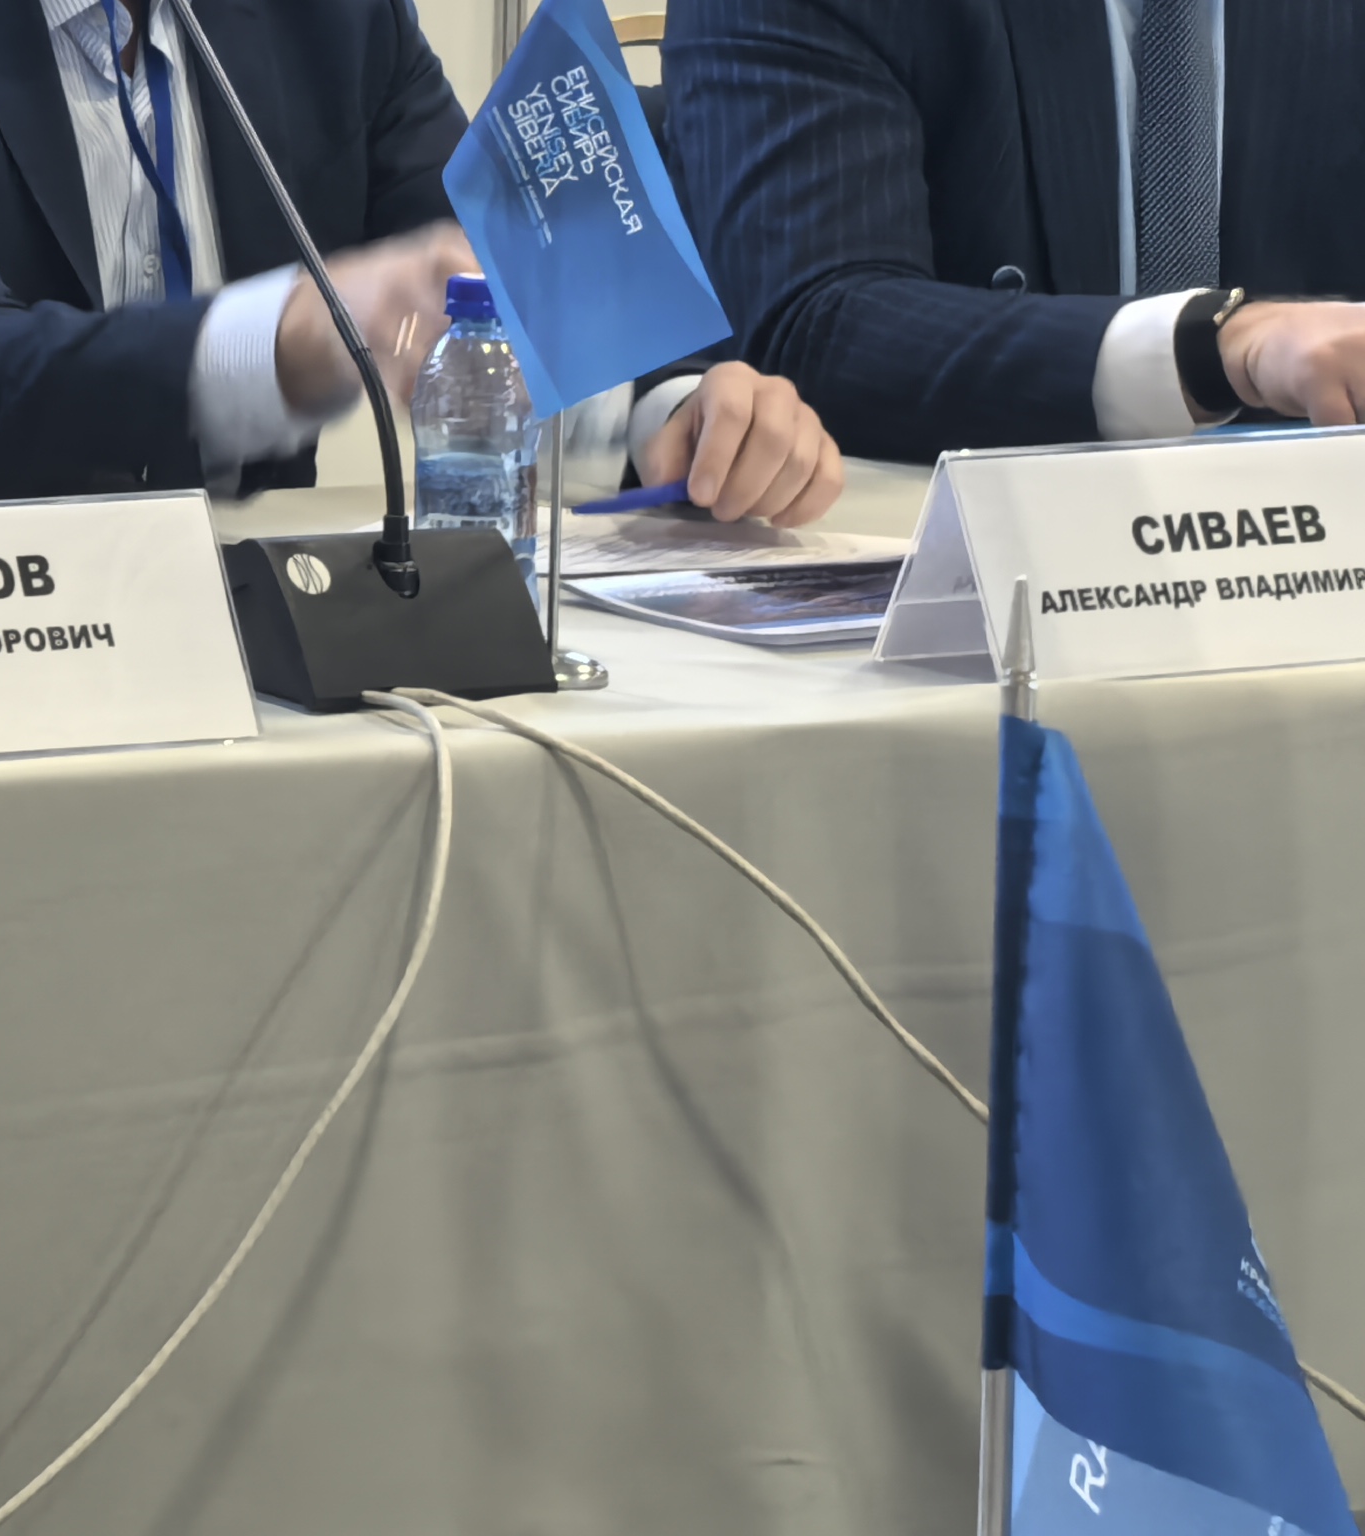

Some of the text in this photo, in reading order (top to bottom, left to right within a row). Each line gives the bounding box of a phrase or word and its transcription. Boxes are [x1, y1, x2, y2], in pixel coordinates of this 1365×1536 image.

[508, 99, 560, 198] SIBERIA
[526, 82, 579, 181] YENISEY
[551, 75, 597, 175] СИБИРЬ
[567, 65, 643, 235] ЕНИСЕЙСКАЯ
[1132, 505, 1326, 555] СИВАЕВ
[1041, 580, 1207, 615] АЛЕКСАНДР
